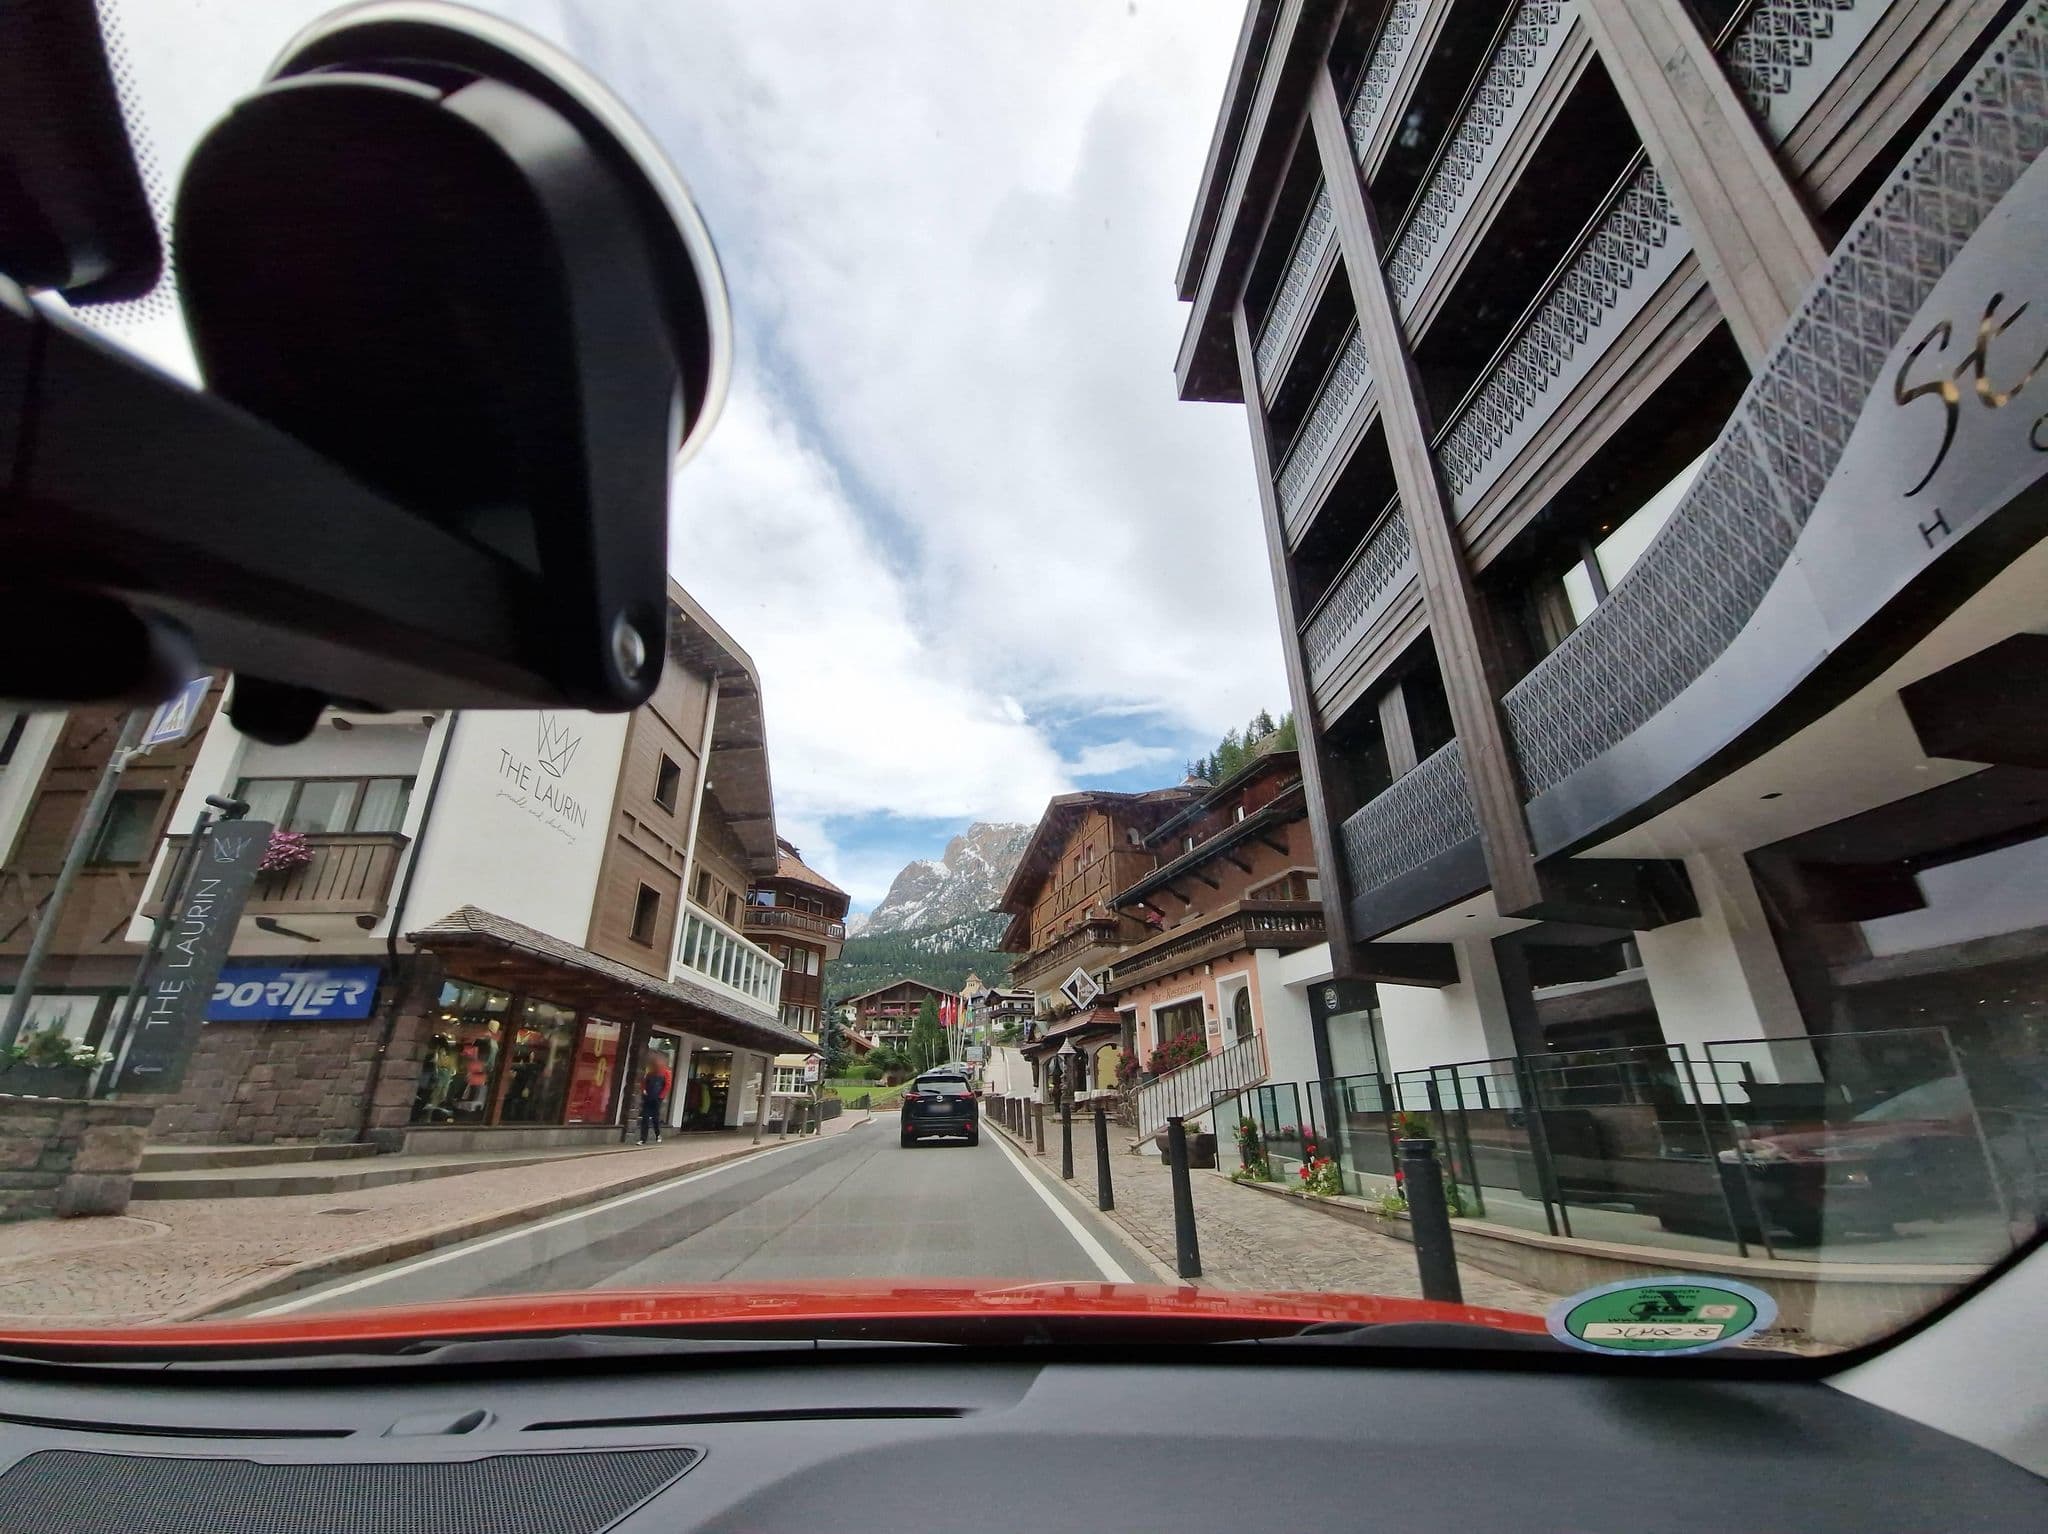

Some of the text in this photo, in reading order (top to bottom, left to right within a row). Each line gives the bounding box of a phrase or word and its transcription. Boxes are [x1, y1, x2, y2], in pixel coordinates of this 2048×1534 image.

[499, 748, 587, 829] THE LAURIN
[145, 980, 184, 1030] THE
[168, 878, 222, 968] LAURIN
[211, 972, 368, 1016] PORTLER
